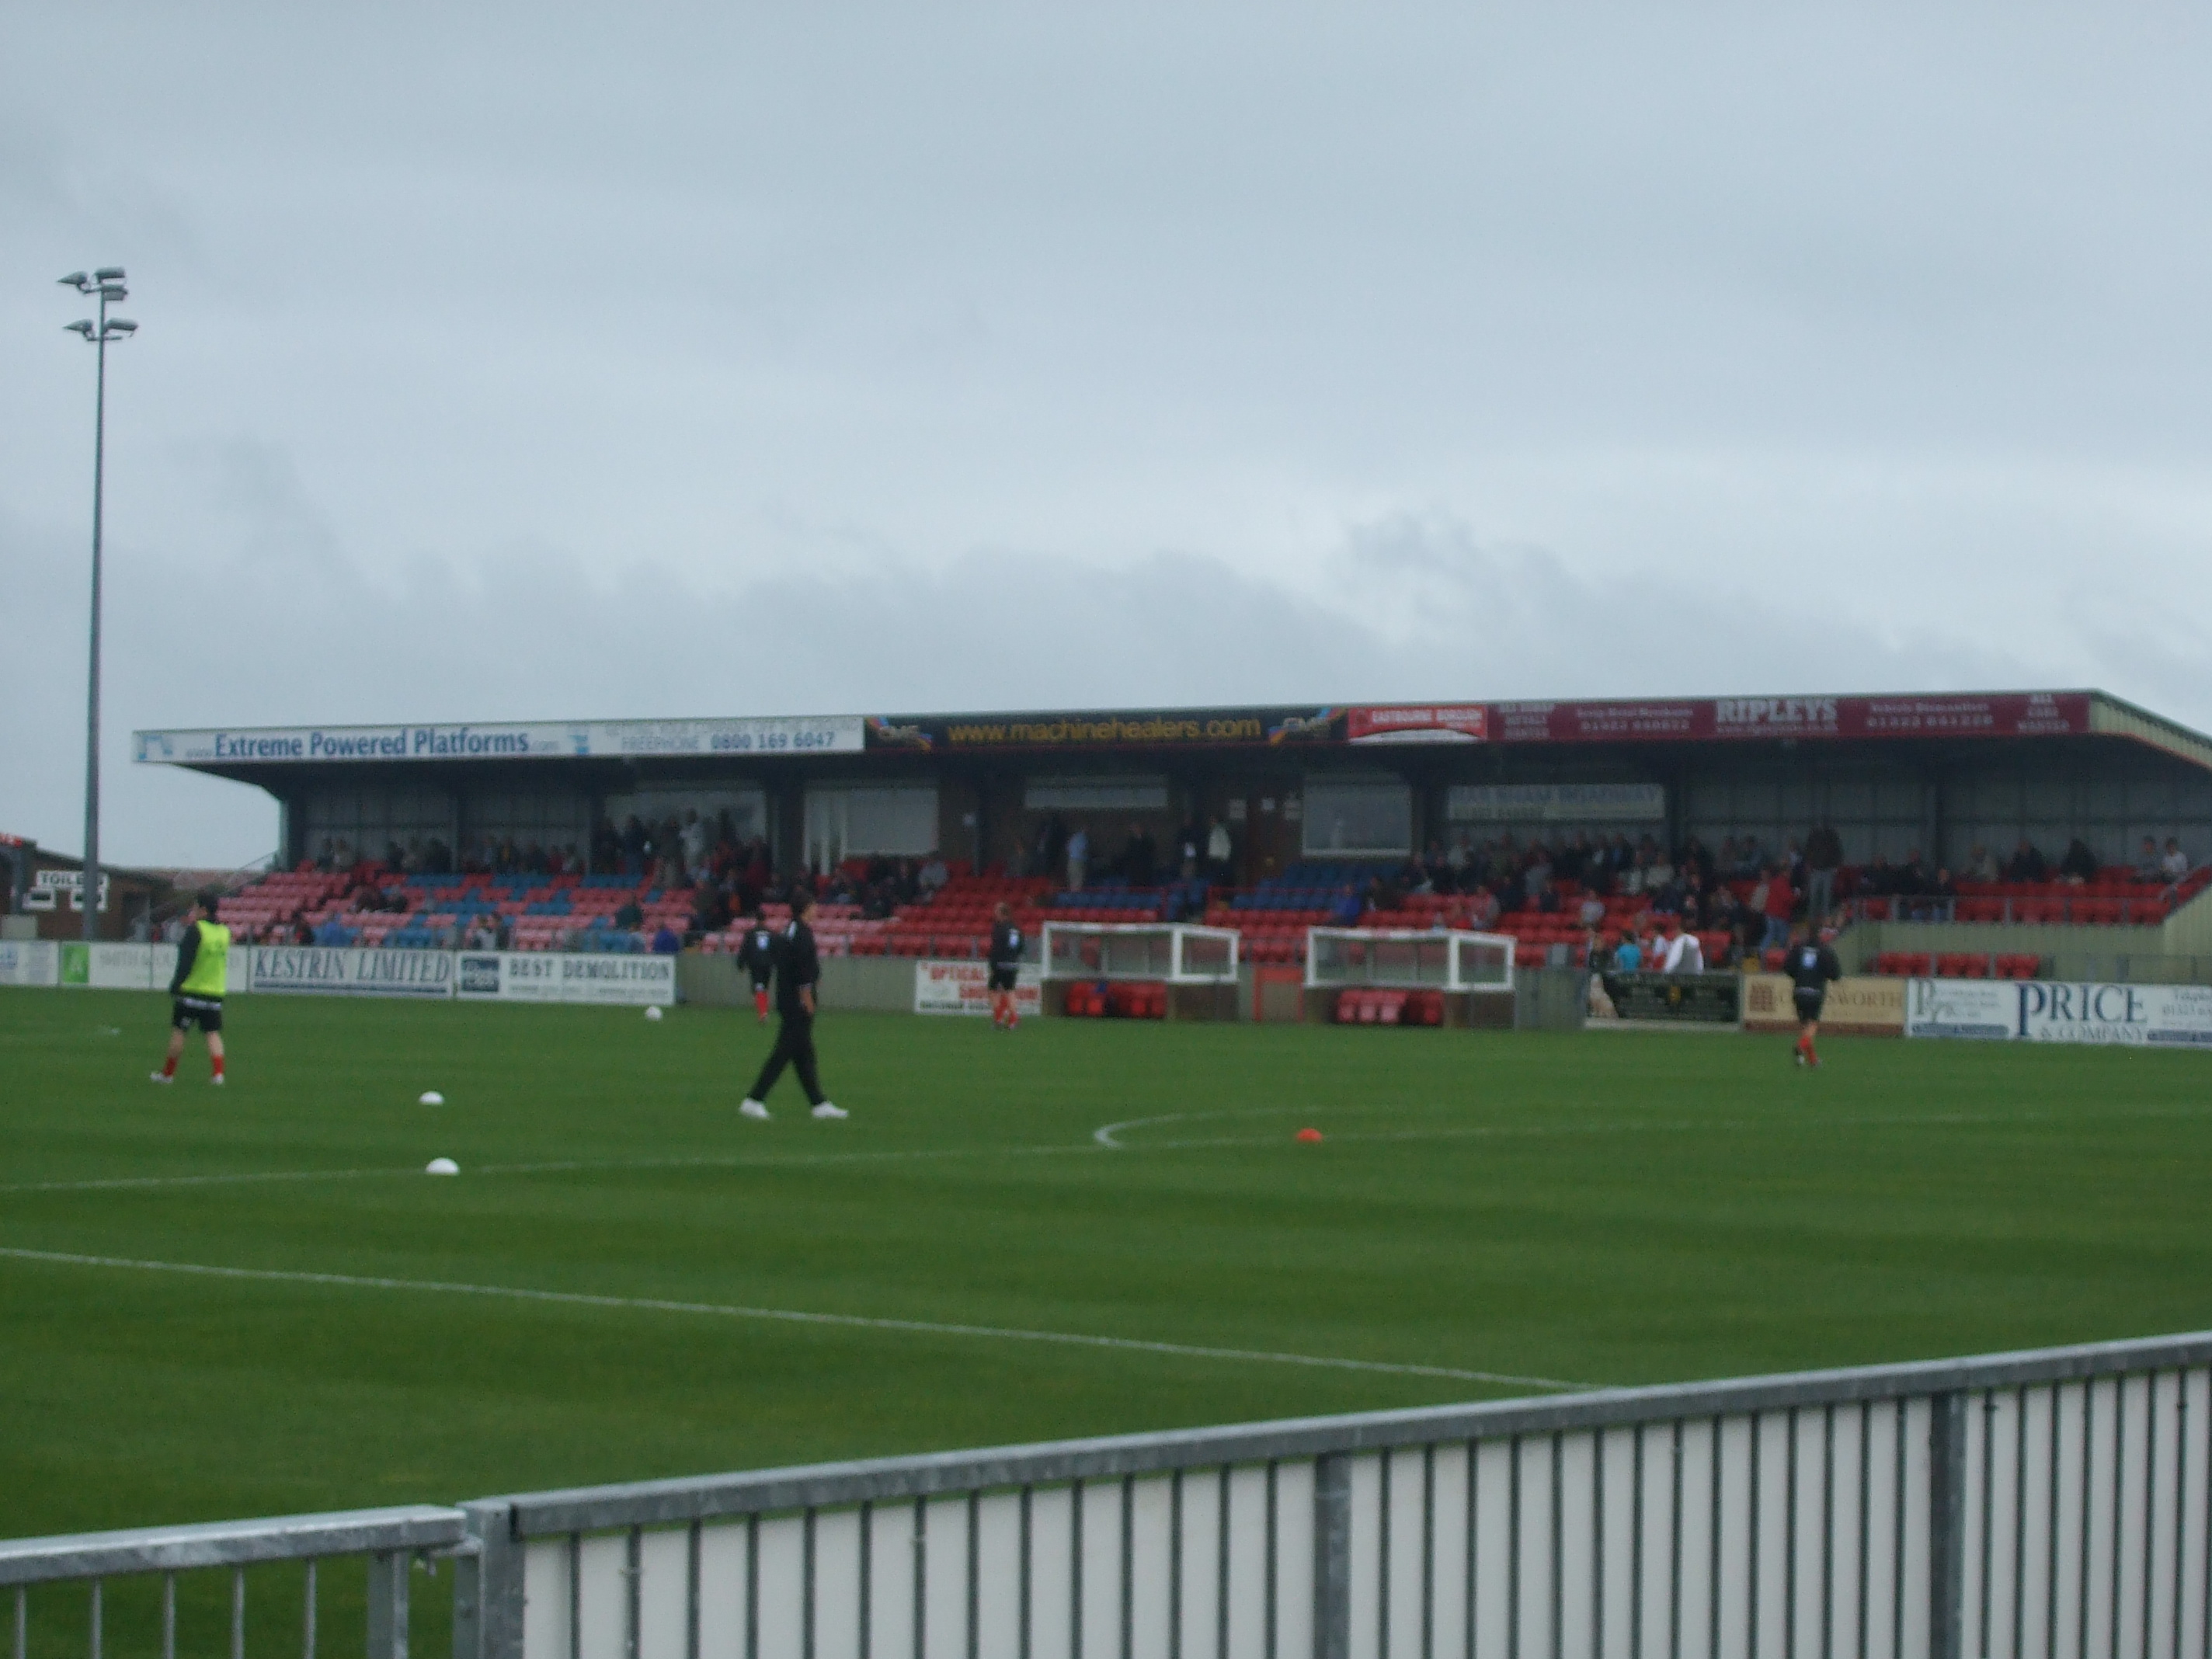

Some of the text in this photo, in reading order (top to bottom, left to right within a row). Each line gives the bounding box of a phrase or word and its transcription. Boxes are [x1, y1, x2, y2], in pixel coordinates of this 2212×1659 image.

[1716, 697, 1838, 722] RIPLEYS
[214, 732, 304, 756] Extreme
[311, 727, 407, 756] Powered
[414, 725, 530, 753] Platforms
[710, 733, 753, 750] 0800
[758, 732, 788, 749] 169
[255, 948, 349, 979] KESTRIN
[356, 950, 451, 983] LIMITED
[509, 958, 554, 977] BEST
[562, 958, 670, 980] DEMOLITION
[2015, 981, 2148, 1037] PRICE
[2059, 1024, 2144, 1042] COMPANY
